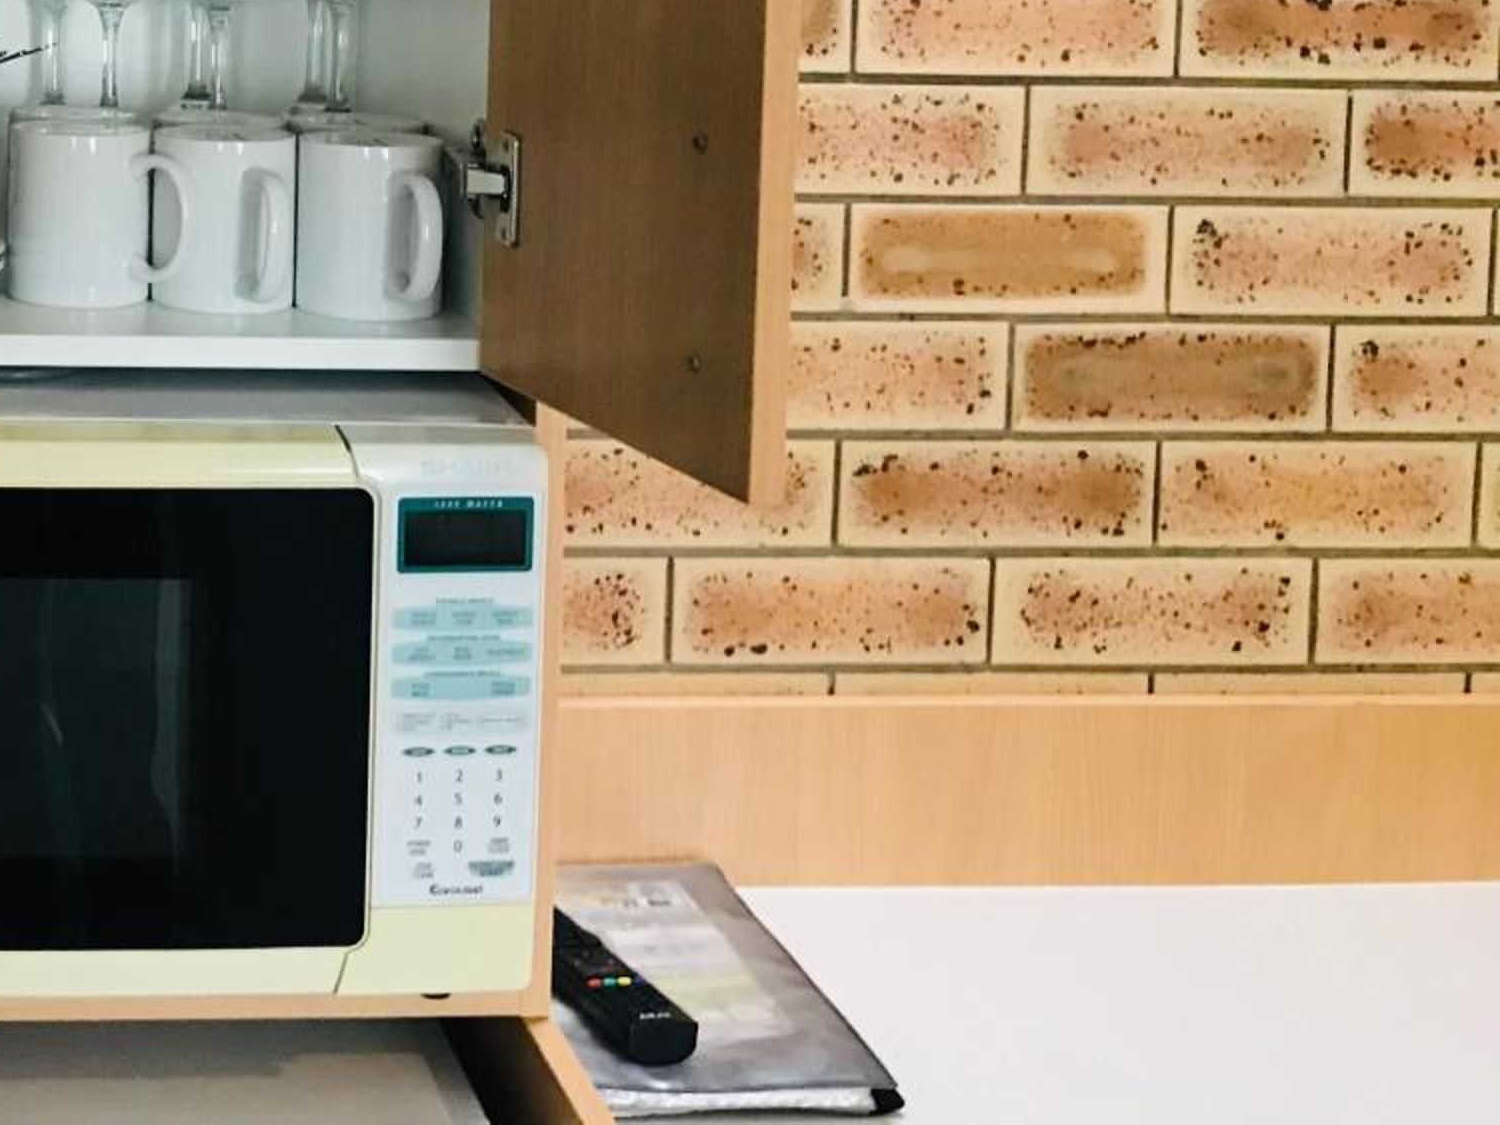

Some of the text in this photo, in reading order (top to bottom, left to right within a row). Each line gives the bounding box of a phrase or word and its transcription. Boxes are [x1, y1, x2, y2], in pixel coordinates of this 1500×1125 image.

[455, 769, 464, 783] 2
[496, 768, 504, 782] 3
[414, 792, 503, 807] 4 5 6
[415, 815, 502, 829] 7 8 9
